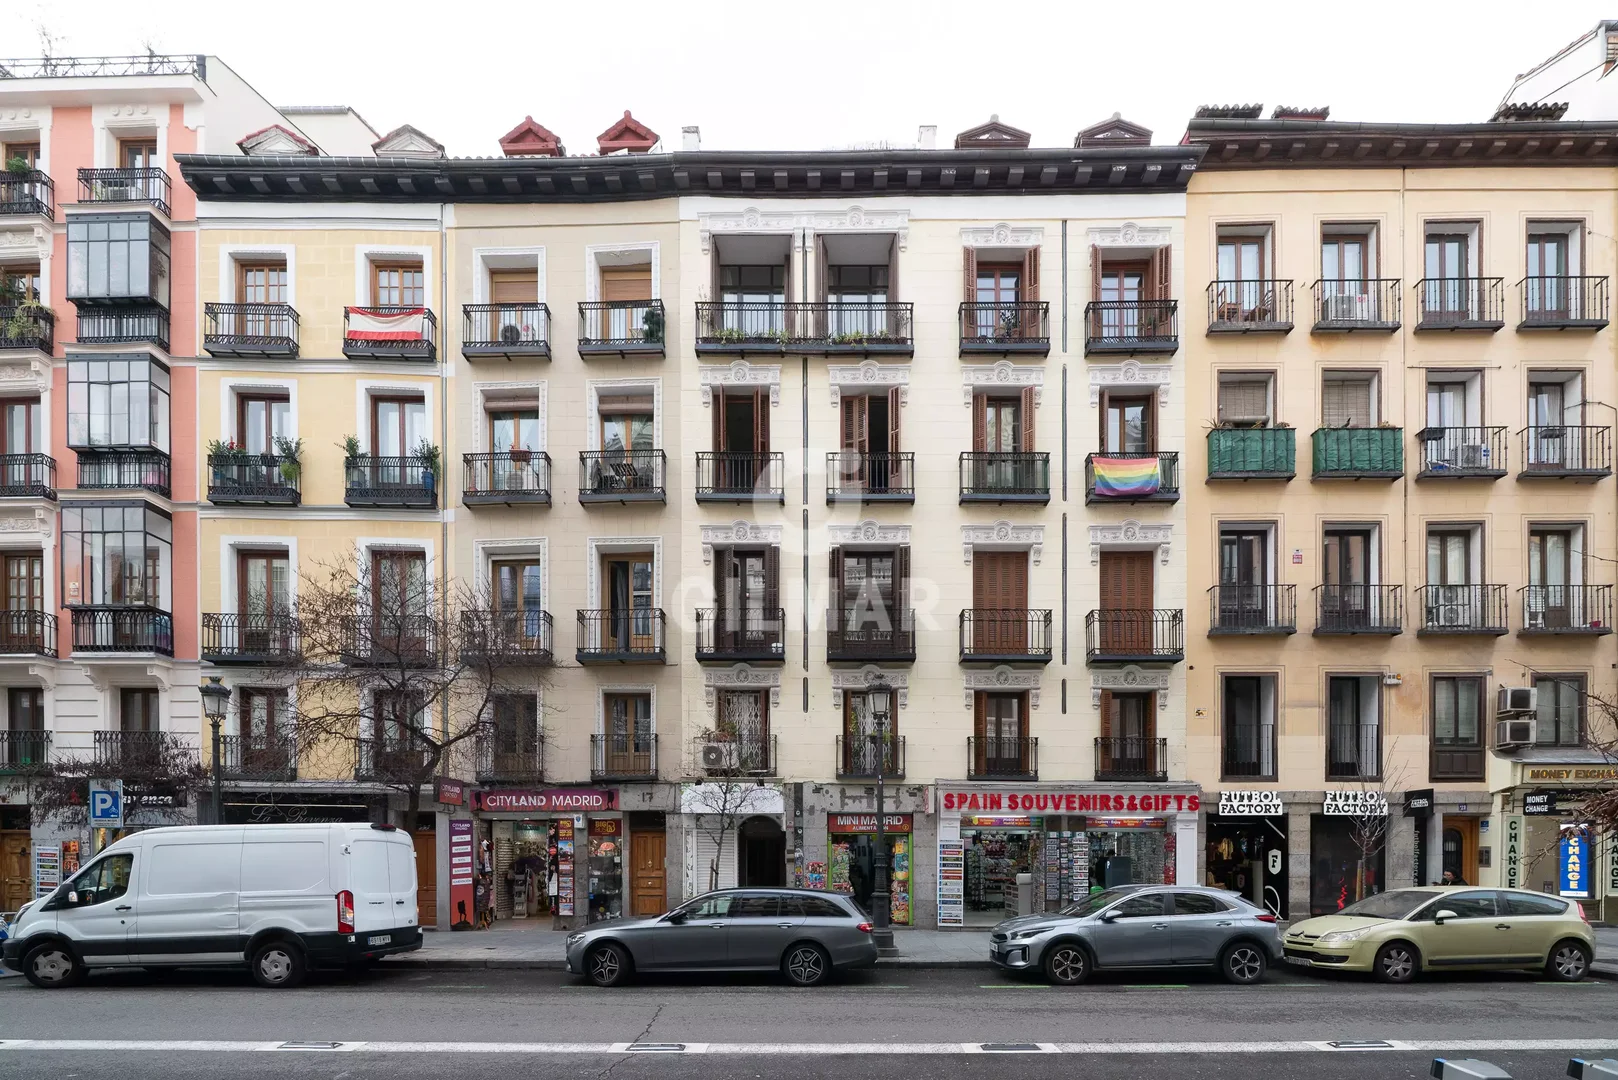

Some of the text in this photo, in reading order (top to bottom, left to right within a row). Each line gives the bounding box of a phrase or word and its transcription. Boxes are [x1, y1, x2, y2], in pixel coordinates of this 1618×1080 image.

[1530, 769, 1572, 779] MONEY
[486, 795, 602, 806] CITYLAND MADRID
[642, 792, 653, 802] 17
[944, 792, 1002, 810] SPAIN
[1008, 794, 1200, 812] SOUVENIRS&GIFTS
[1220, 791, 1280, 802] FUTBOL
[1325, 791, 1386, 802] FUTBOL
[1526, 794, 1548, 804] MONEY
[95, 793, 112, 816] P
[1220, 804, 1280, 814] FACTORY
[1326, 804, 1386, 814] FACTORY
[1525, 804, 1548, 813] CHANGE
[838, 816, 858, 825] MINI
[1508, 820, 1518, 888] CHANGE
[1271, 855, 1278, 868] F
[1568, 838, 1581, 889] CHANGE
